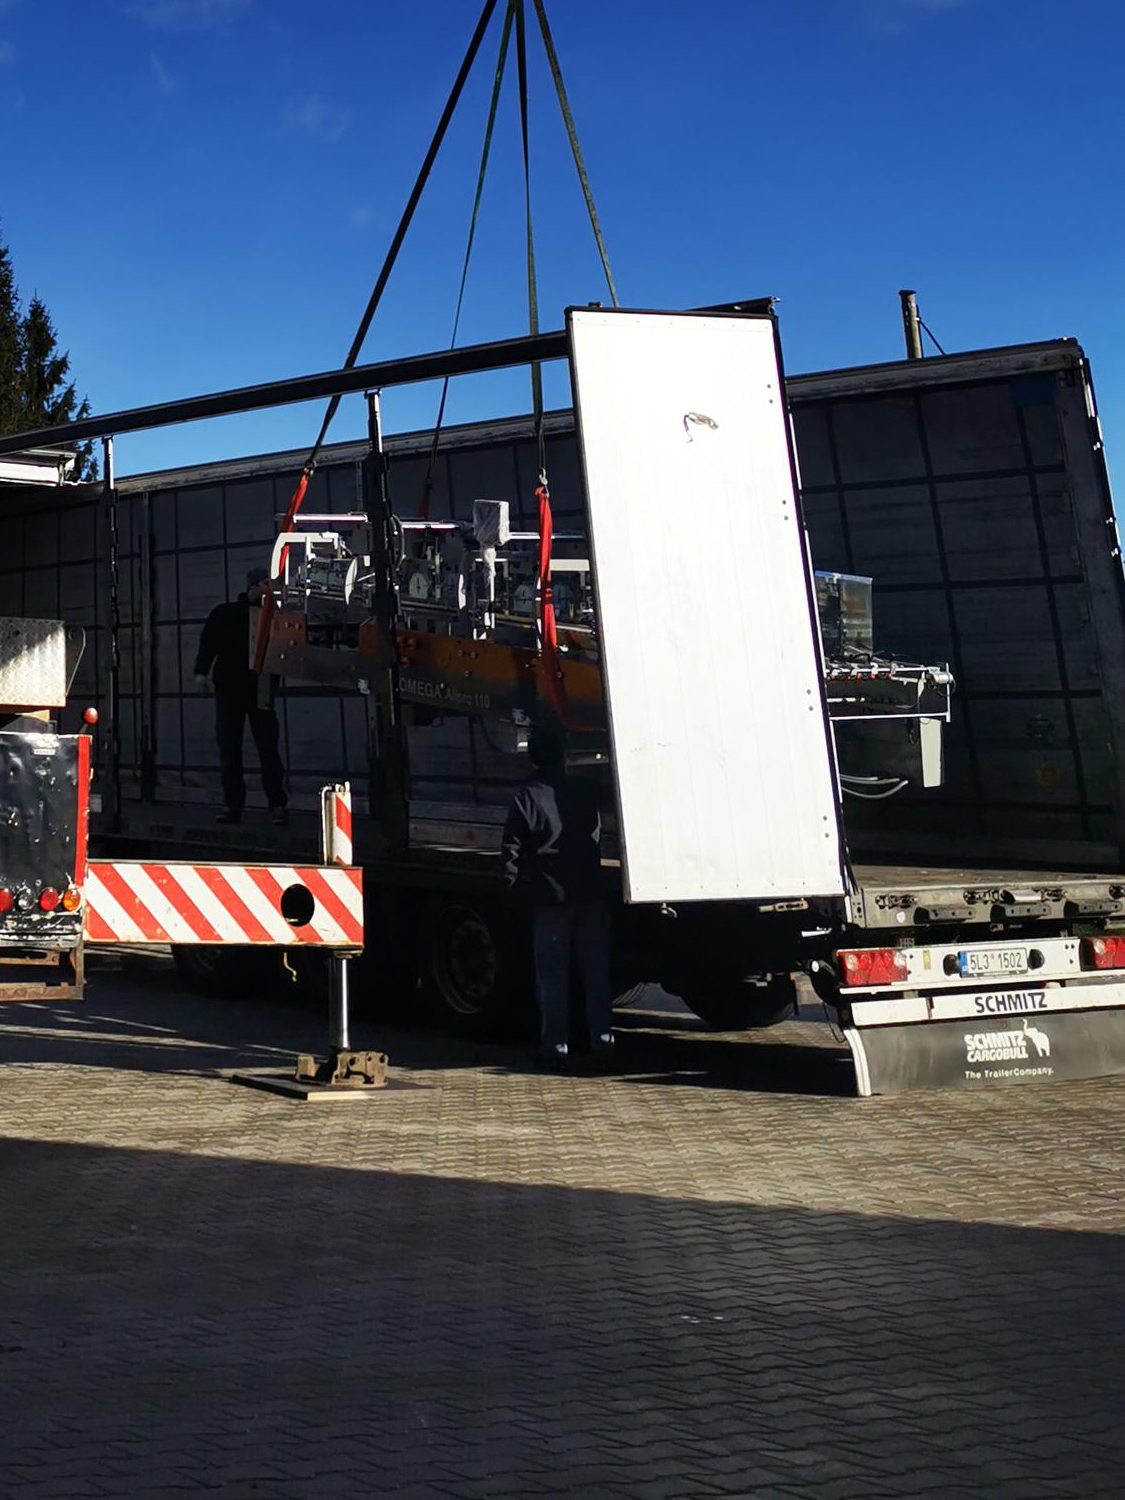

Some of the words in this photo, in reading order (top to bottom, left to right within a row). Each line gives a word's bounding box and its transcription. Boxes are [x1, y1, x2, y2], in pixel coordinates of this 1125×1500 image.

[398, 676, 442, 700] OMEGA
[474, 692, 491, 709] 110
[970, 954, 989, 970] 5L3
[998, 952, 1022, 968] 1502
[974, 992, 1047, 1013] SCHMITZ
[964, 1030, 1027, 1051] SCHMITZ
[966, 1047, 1028, 1062] CARGOBULL
[964, 1071, 981, 1079] The
